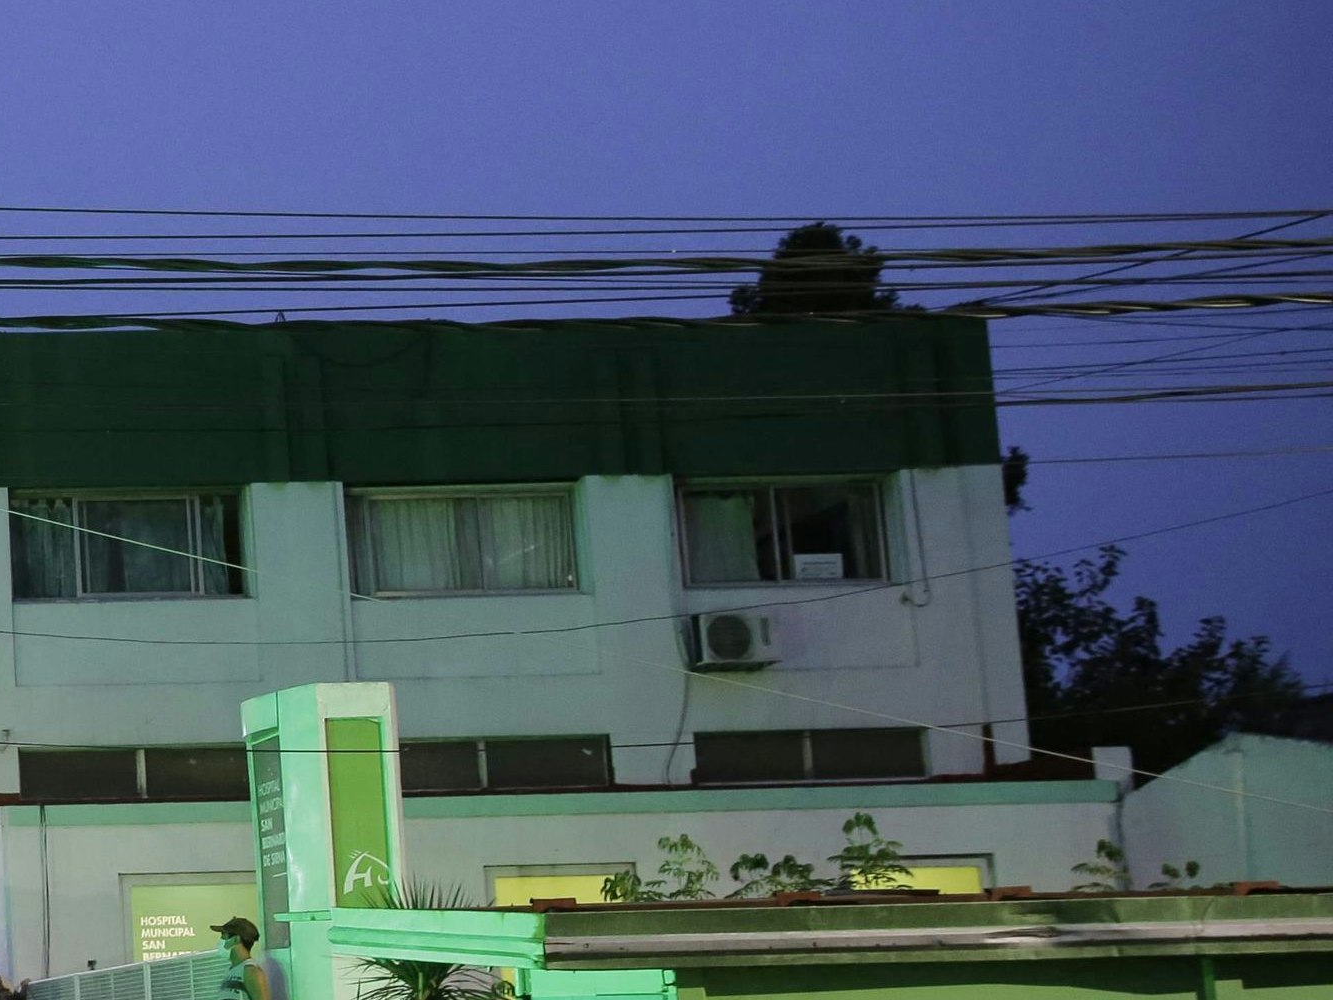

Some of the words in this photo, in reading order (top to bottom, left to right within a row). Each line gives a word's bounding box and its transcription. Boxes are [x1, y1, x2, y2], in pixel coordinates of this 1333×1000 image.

[261, 818, 273, 832] SAN
[140, 915, 188, 926] HOSPITAL
[141, 927, 196, 939] MUNICIPAL
[142, 940, 166, 950] SAN
